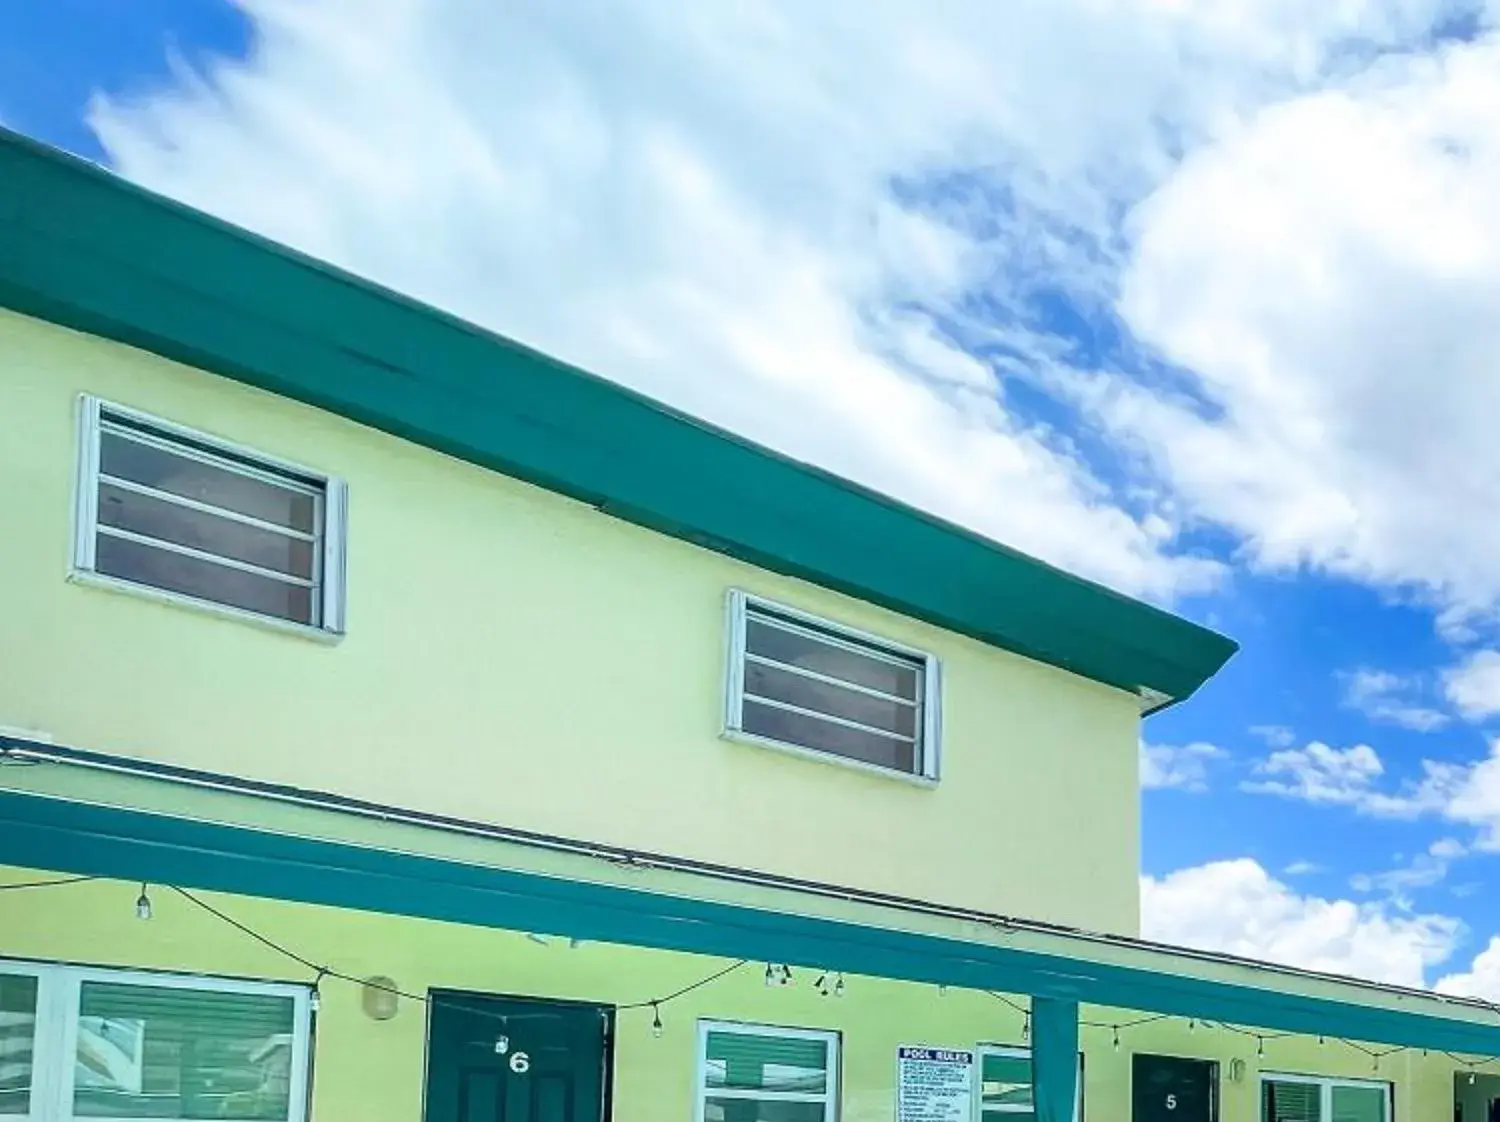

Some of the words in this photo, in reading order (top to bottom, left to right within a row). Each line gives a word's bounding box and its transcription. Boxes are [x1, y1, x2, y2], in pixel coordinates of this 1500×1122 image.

[509, 1051, 529, 1073] 6
[903, 1048, 932, 1060] POOL
[935, 1051, 969, 1063] RULES
[1166, 1093, 1177, 1110] 5
